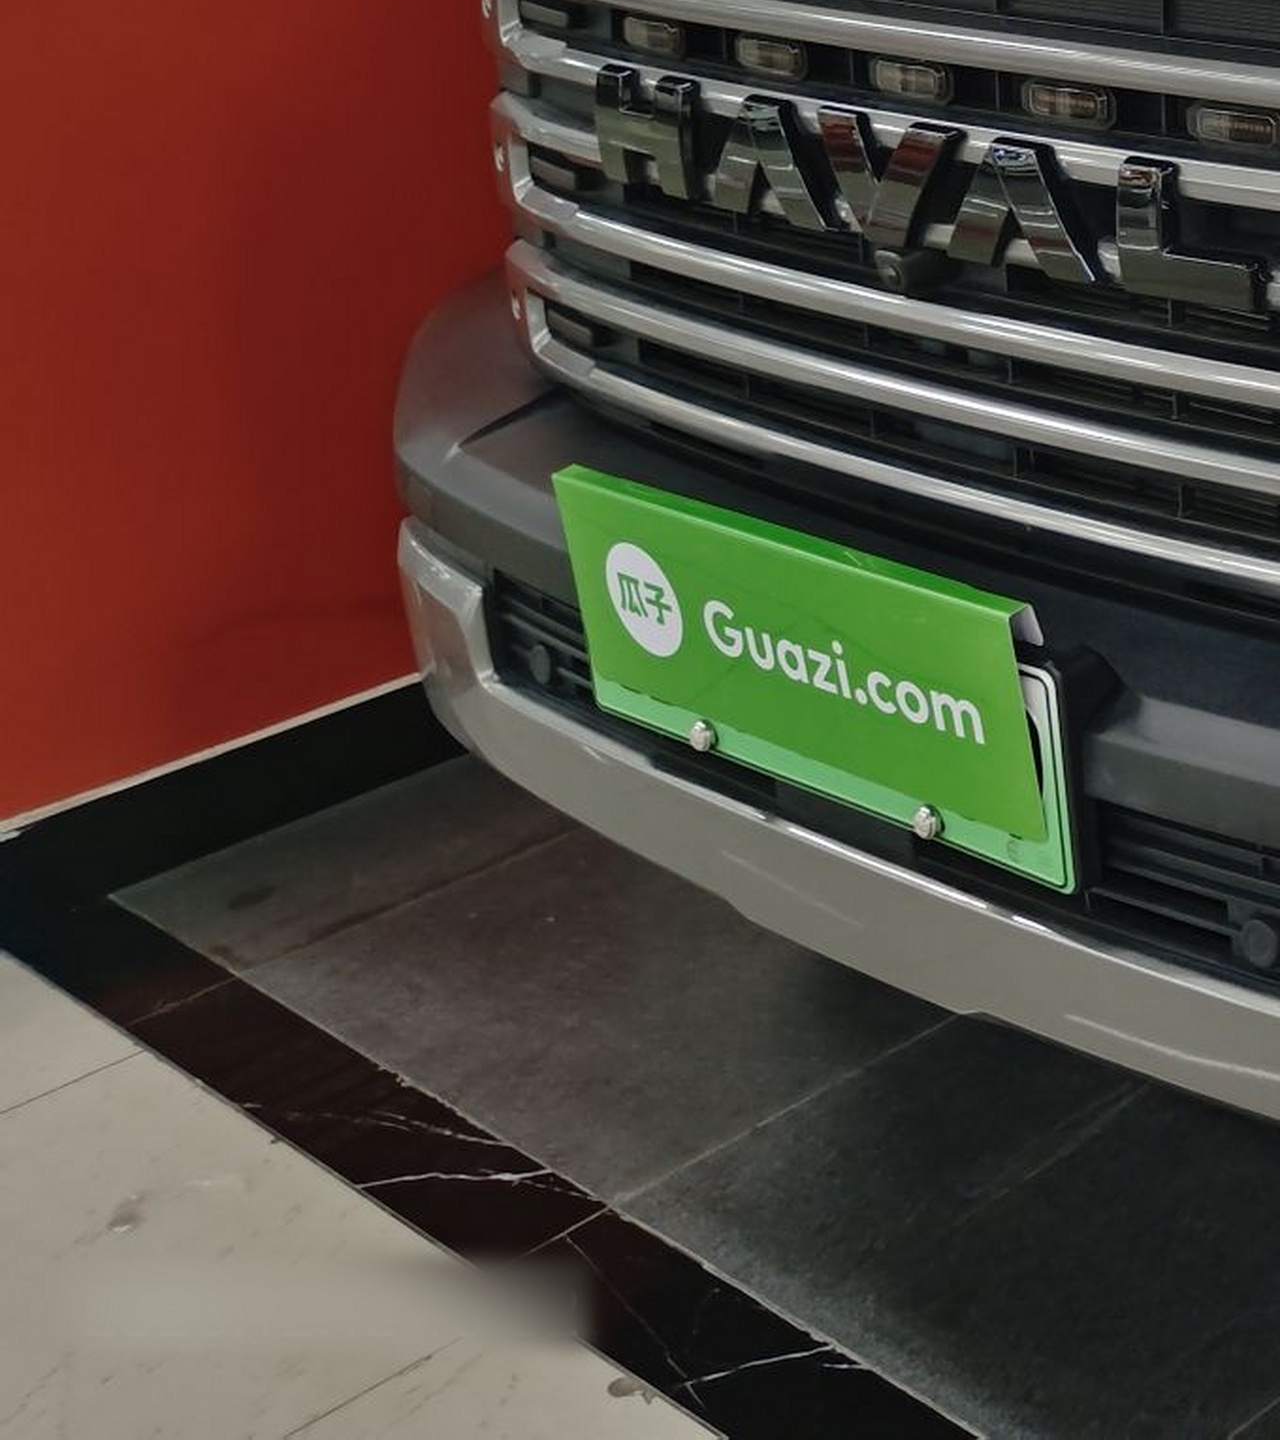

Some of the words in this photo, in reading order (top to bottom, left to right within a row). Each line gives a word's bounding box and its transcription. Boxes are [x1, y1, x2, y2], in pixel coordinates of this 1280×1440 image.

[596, 63, 1272, 312] HAVAL
[617, 571, 673, 626] 瓜子
[703, 599, 986, 745] Guazi.com
